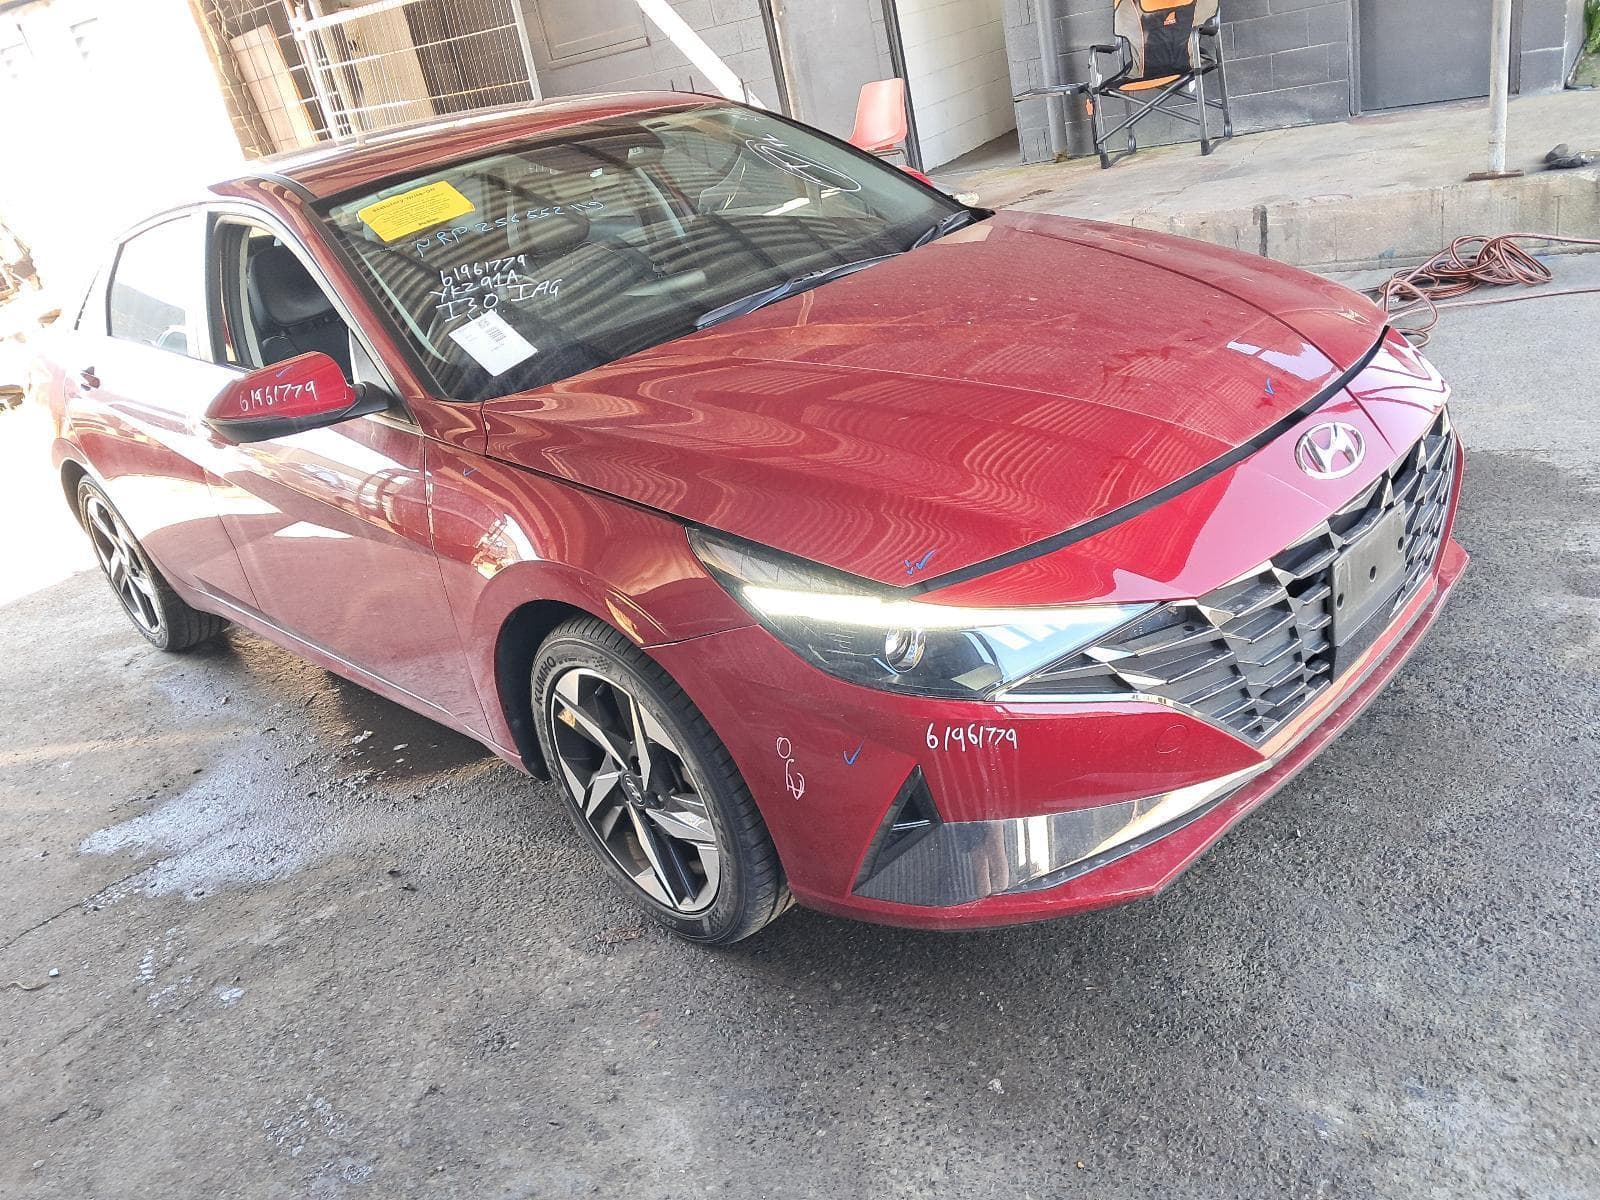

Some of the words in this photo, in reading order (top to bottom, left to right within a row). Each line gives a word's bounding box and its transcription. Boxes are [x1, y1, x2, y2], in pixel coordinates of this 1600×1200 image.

[440, 254, 526, 287] 61961779
[240, 380, 318, 412] 61961779
[534, 656, 557, 706] KUMHO
[926, 722, 1018, 752] 61961779
